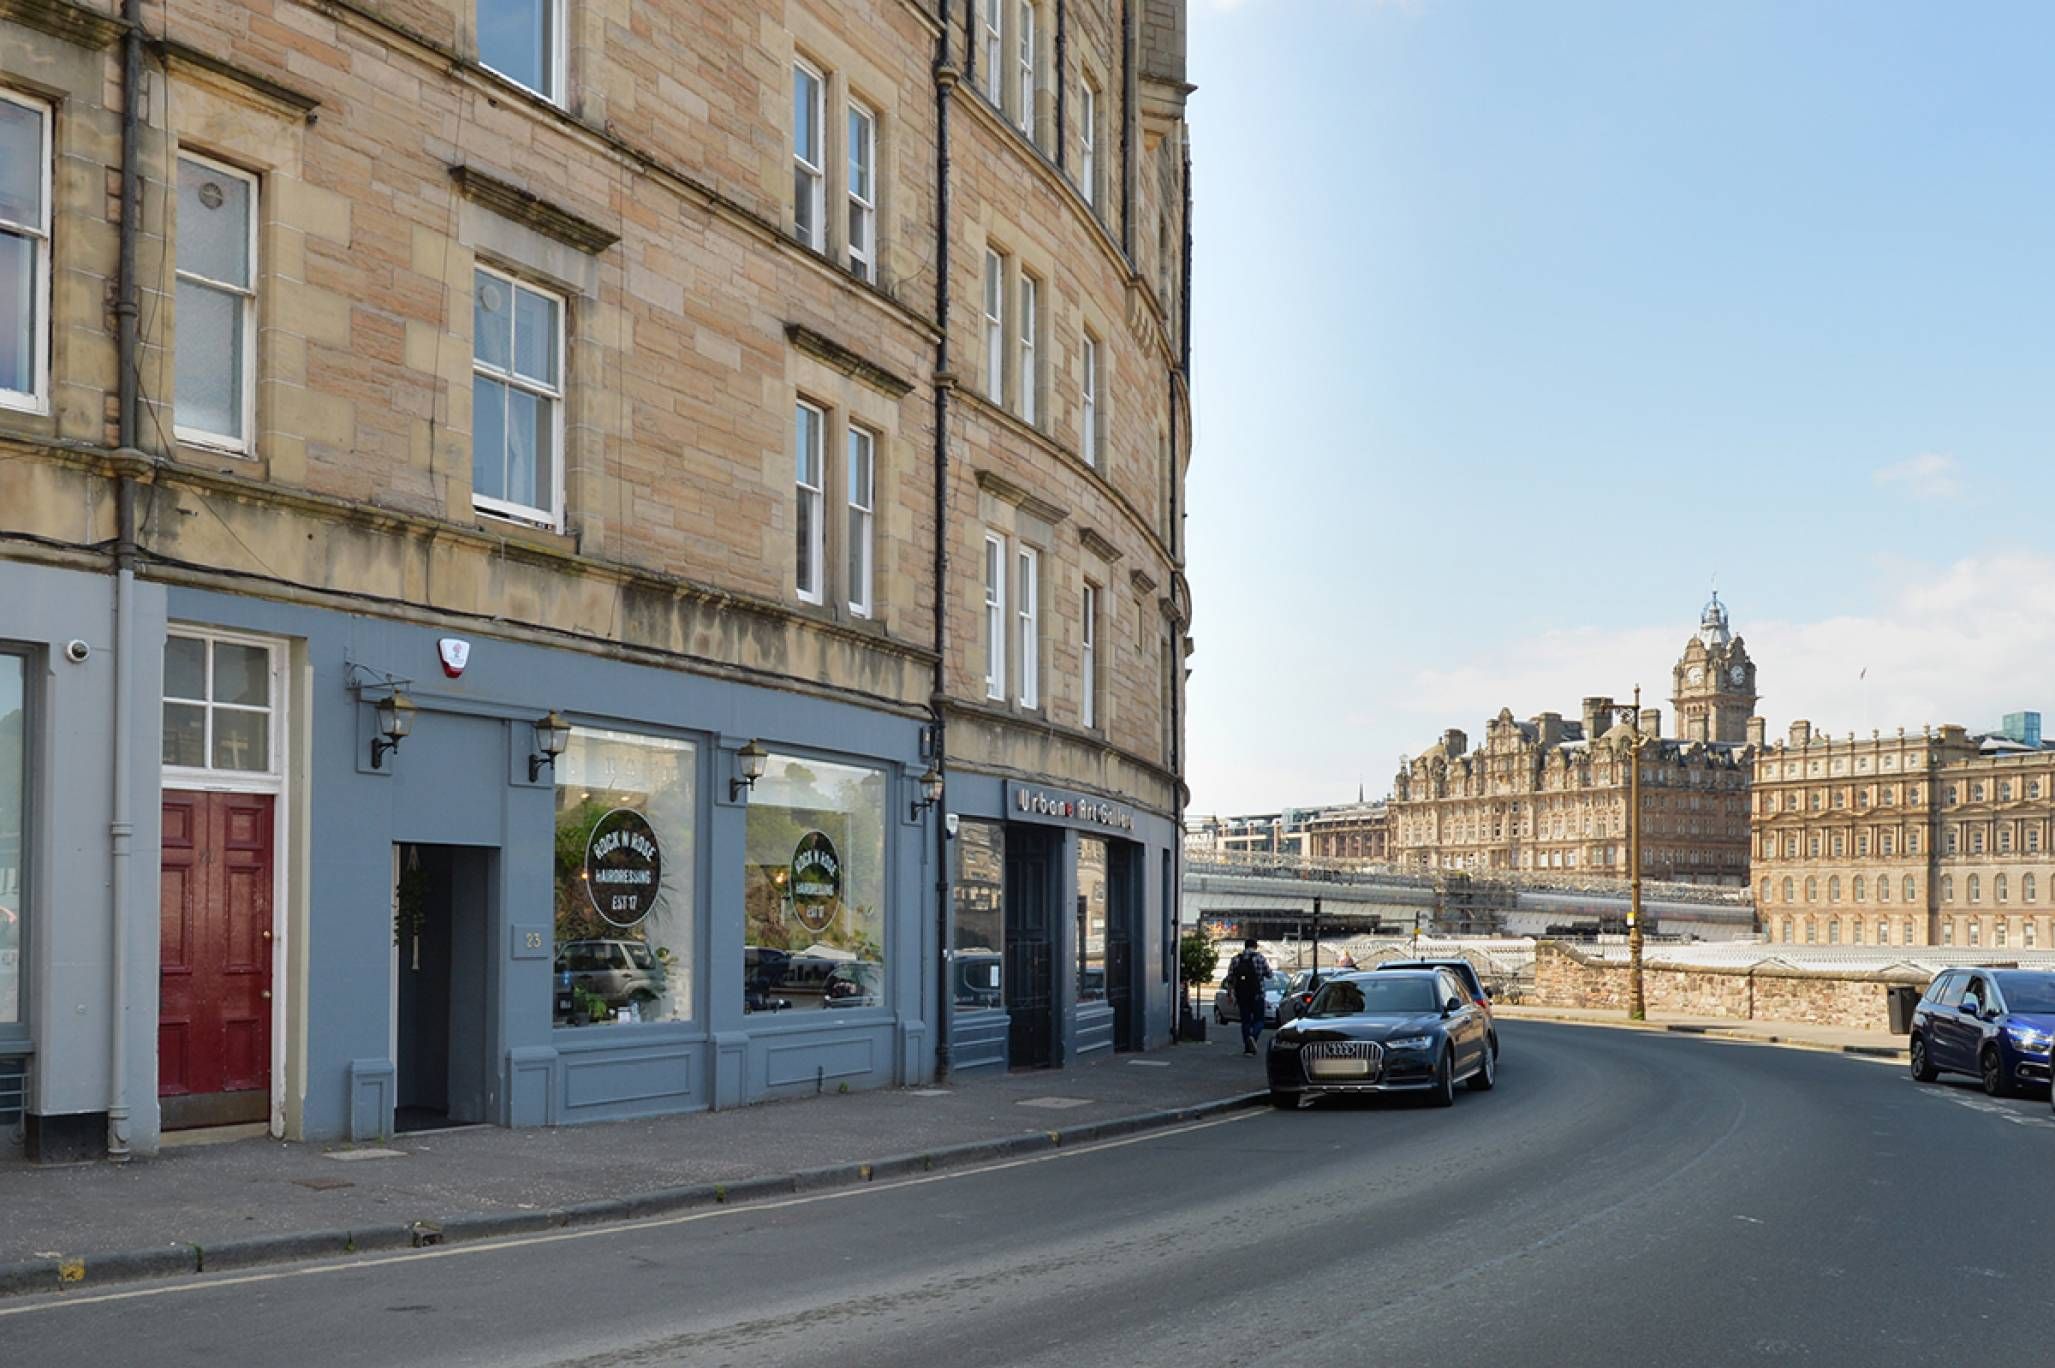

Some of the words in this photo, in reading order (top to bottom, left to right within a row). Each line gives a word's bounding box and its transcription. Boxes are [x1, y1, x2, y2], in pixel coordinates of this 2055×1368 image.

[1018, 788, 1073, 817] Urbane
[1077, 799, 1097, 821] Art
[593, 831, 620, 860] ROCK
[621, 830, 629, 848] N
[631, 832, 657, 862] ROSE
[595, 868, 651, 884] HAIRDRESSING
[794, 850, 813, 874] ROCK
[820, 851, 837, 876] ROSE
[612, 895, 628, 910] EST
[628, 895, 638, 910] 17
